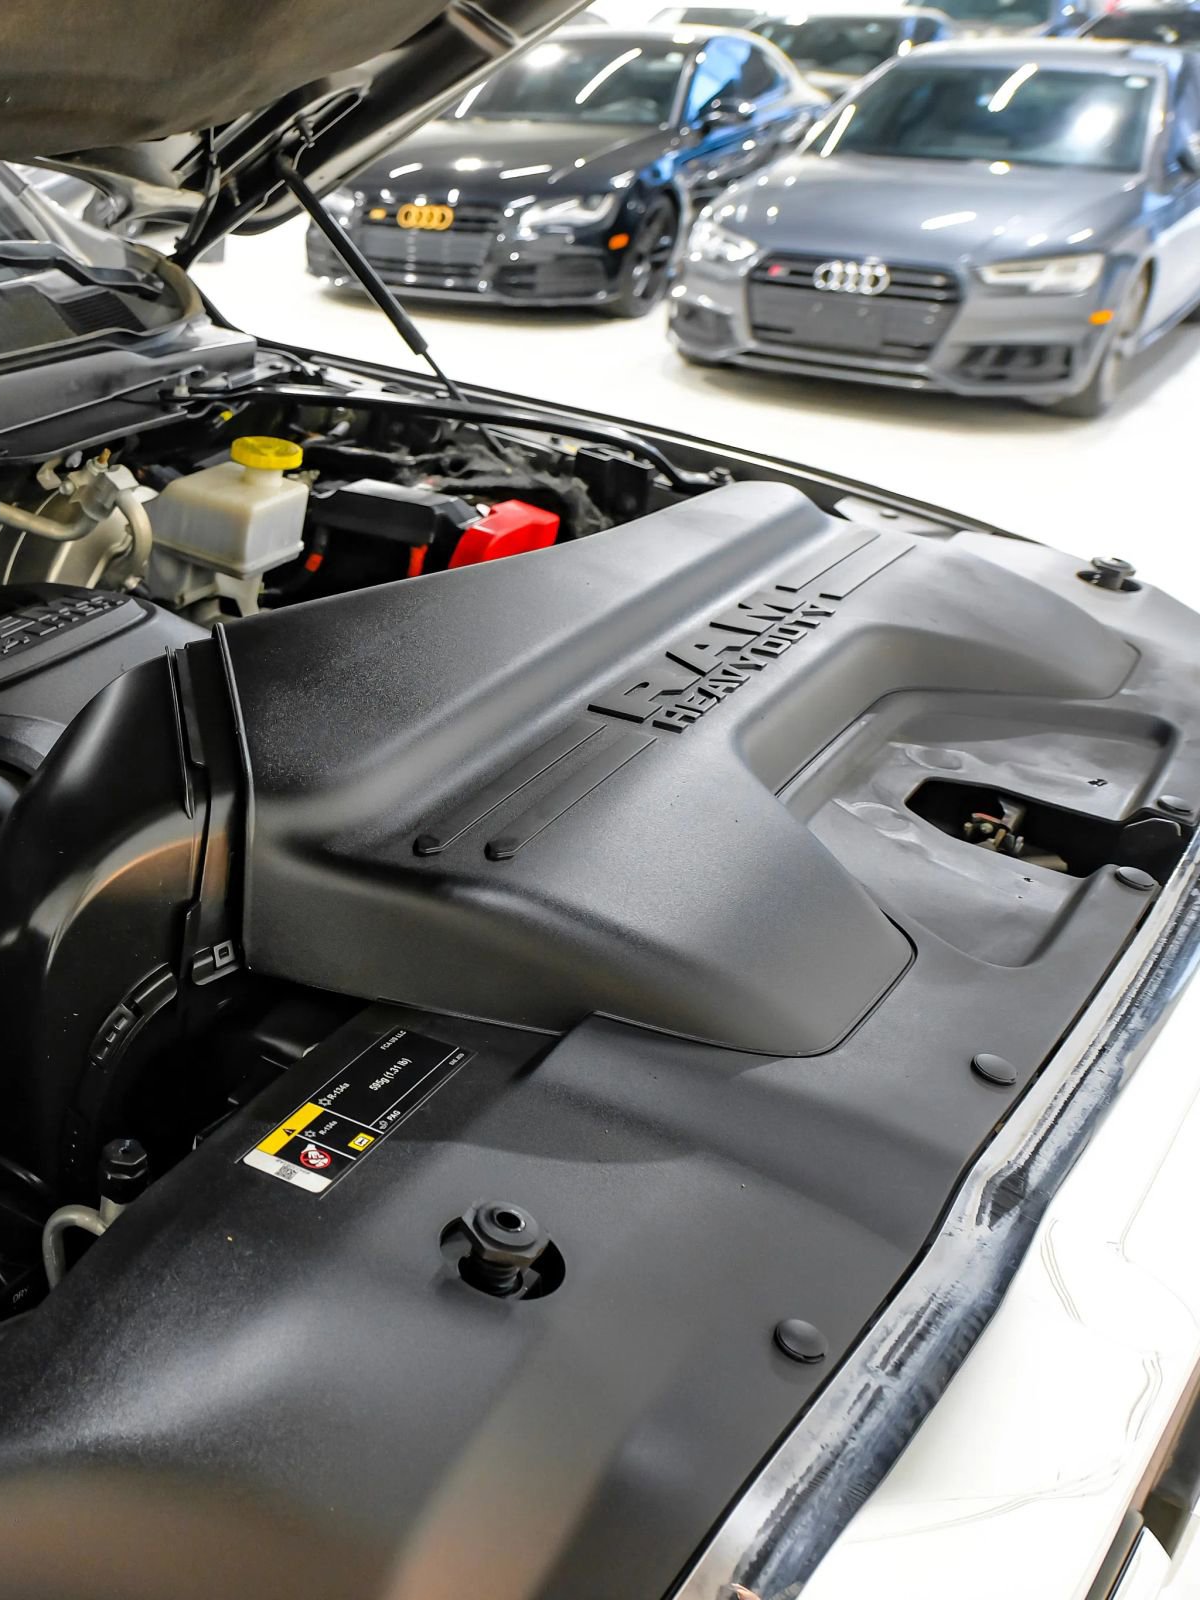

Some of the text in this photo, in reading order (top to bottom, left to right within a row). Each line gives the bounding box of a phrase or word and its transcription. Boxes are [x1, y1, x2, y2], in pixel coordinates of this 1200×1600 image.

[587, 592, 807, 724] RAM
[652, 604, 836, 733] HEAVY DUTY
[368, 1057, 413, 1091] 595g (1.31 lb)
[326, 1082, 351, 1100] R-134a
[318, 1120, 338, 1135] R-134a
[386, 1109, 401, 1122] PAG
